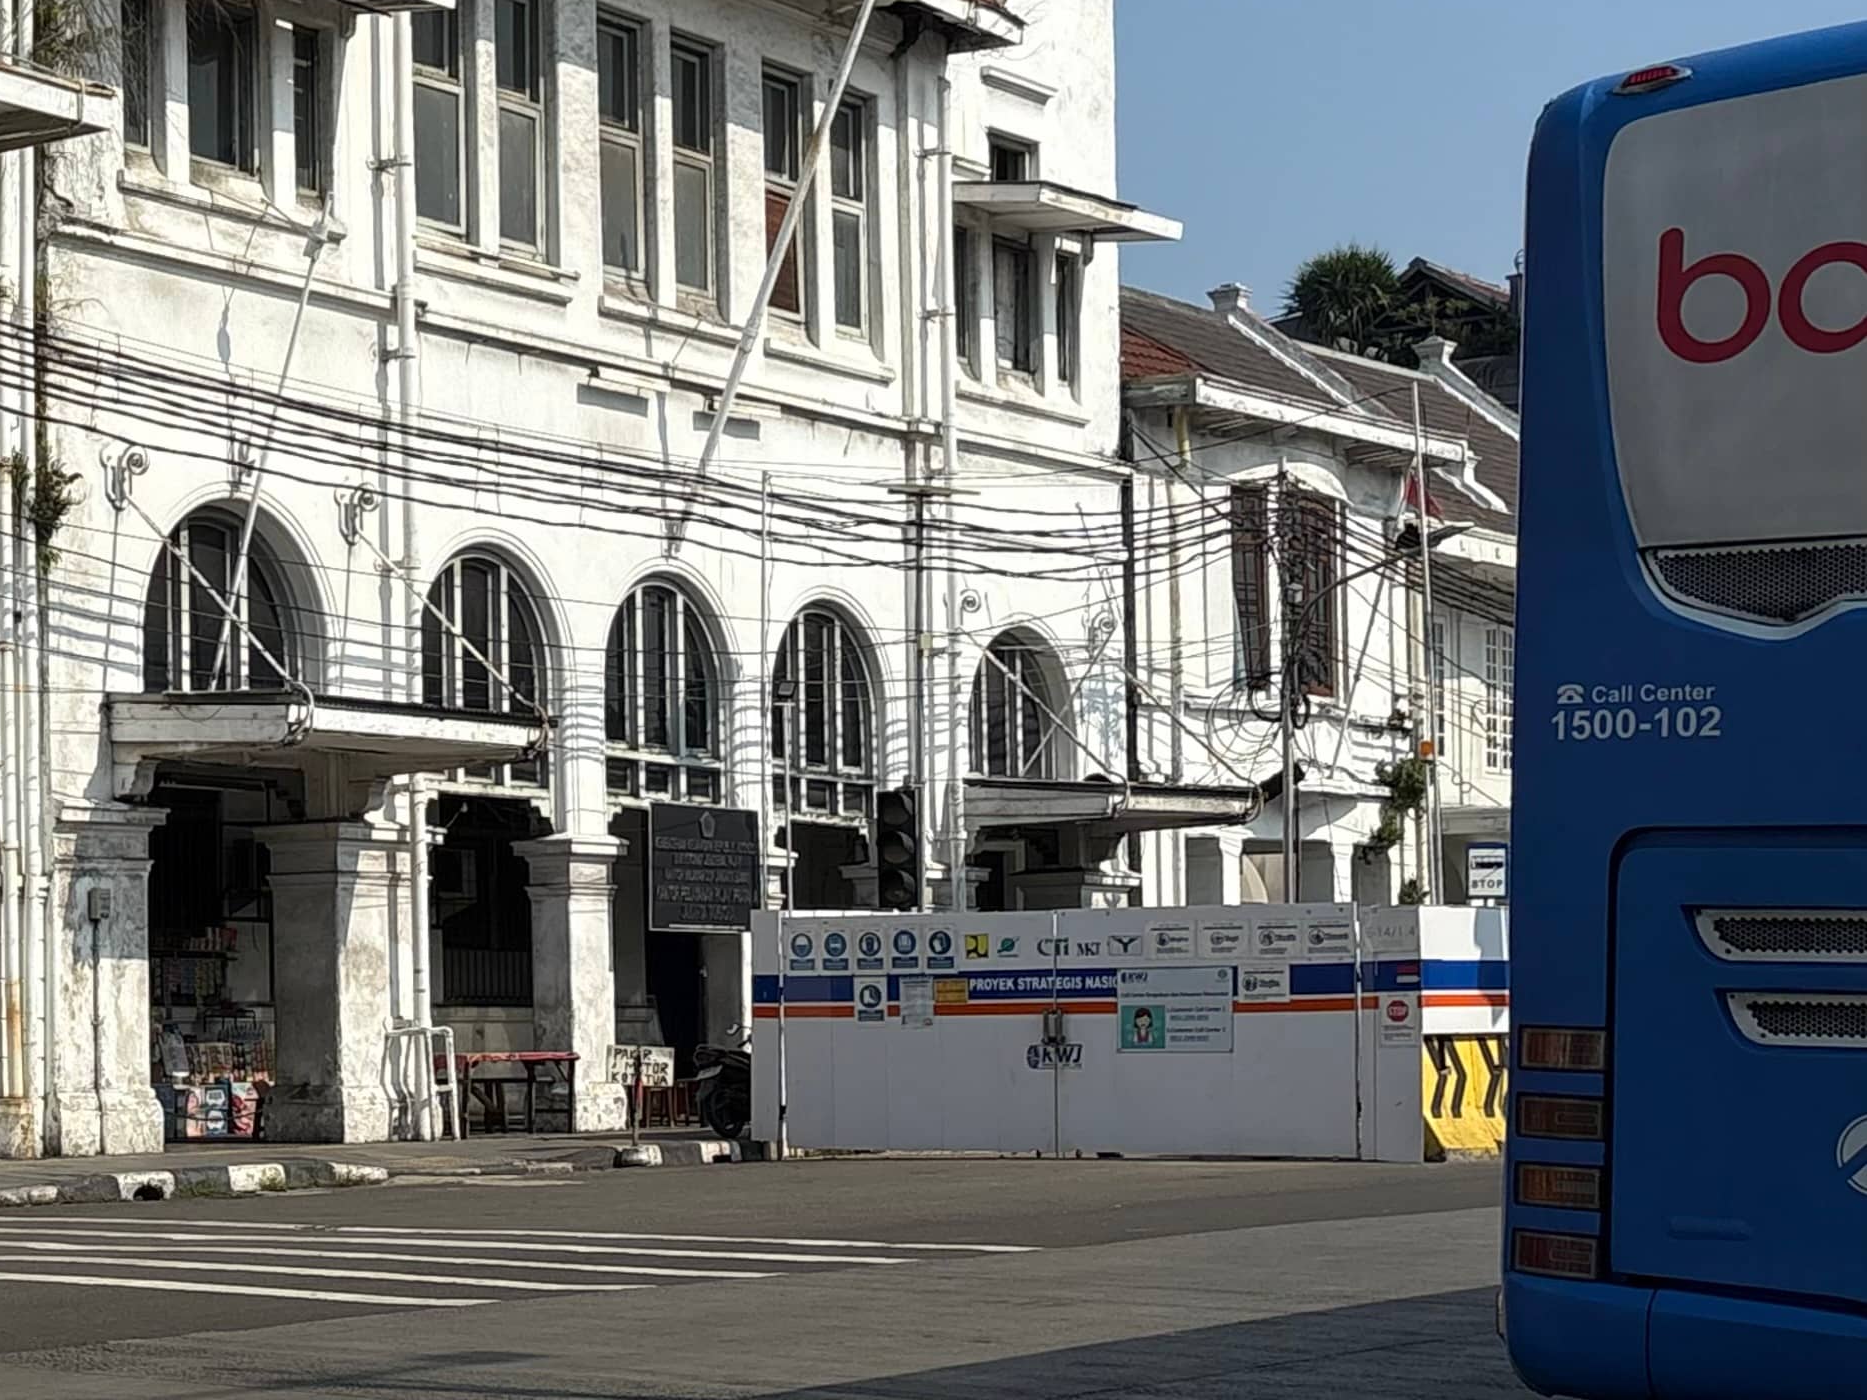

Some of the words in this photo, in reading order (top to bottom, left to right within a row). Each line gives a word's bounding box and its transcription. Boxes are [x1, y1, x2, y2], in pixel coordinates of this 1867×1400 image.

[1591, 685, 1633, 703] Call
[1640, 684, 1716, 702] Center
[1551, 706, 1722, 740] 1500-102
[969, 977, 1015, 991] PROYEK
[1017, 976, 1083, 990] STRATEGIS
[625, 1062, 669, 1075] MTOR
[612, 1072, 640, 1084] KOT
[645, 1074, 669, 1086] TUA
